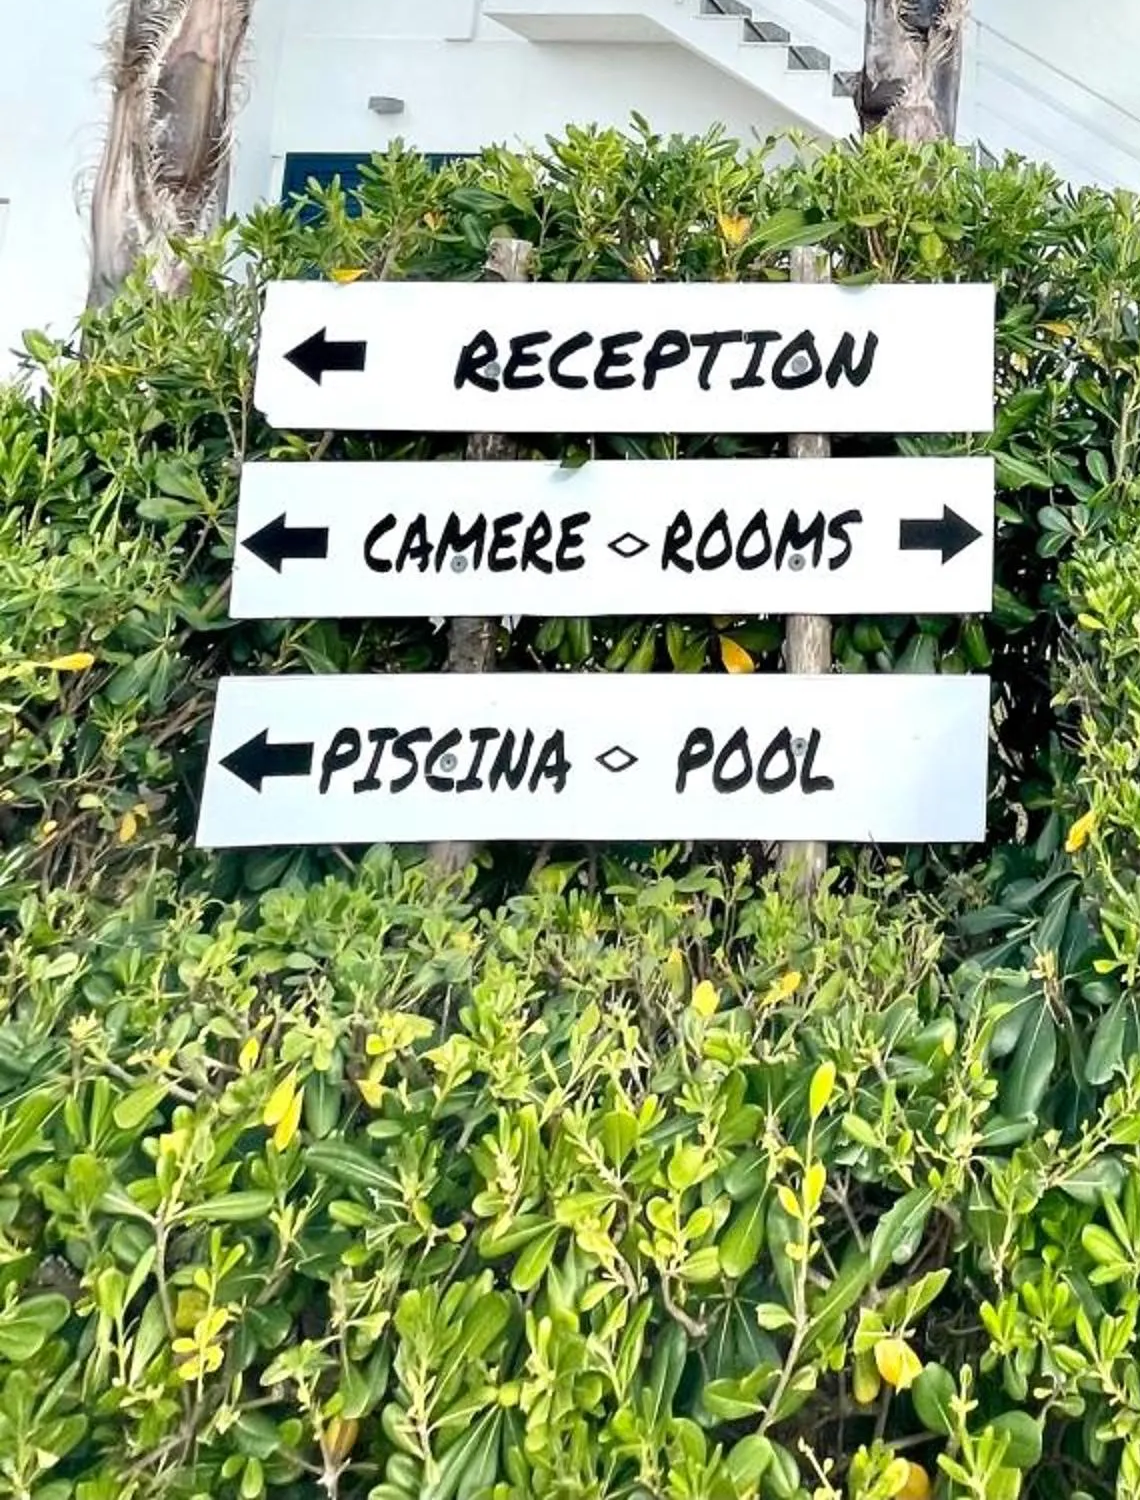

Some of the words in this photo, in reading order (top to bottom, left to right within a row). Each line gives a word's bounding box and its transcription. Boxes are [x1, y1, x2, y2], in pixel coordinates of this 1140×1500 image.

[454, 329, 879, 393] RECEPTION
[364, 510, 591, 574] CAMERE
[661, 508, 863, 573] ROOMS
[320, 727, 572, 795] PISCINA
[676, 726, 834, 794] POOL
